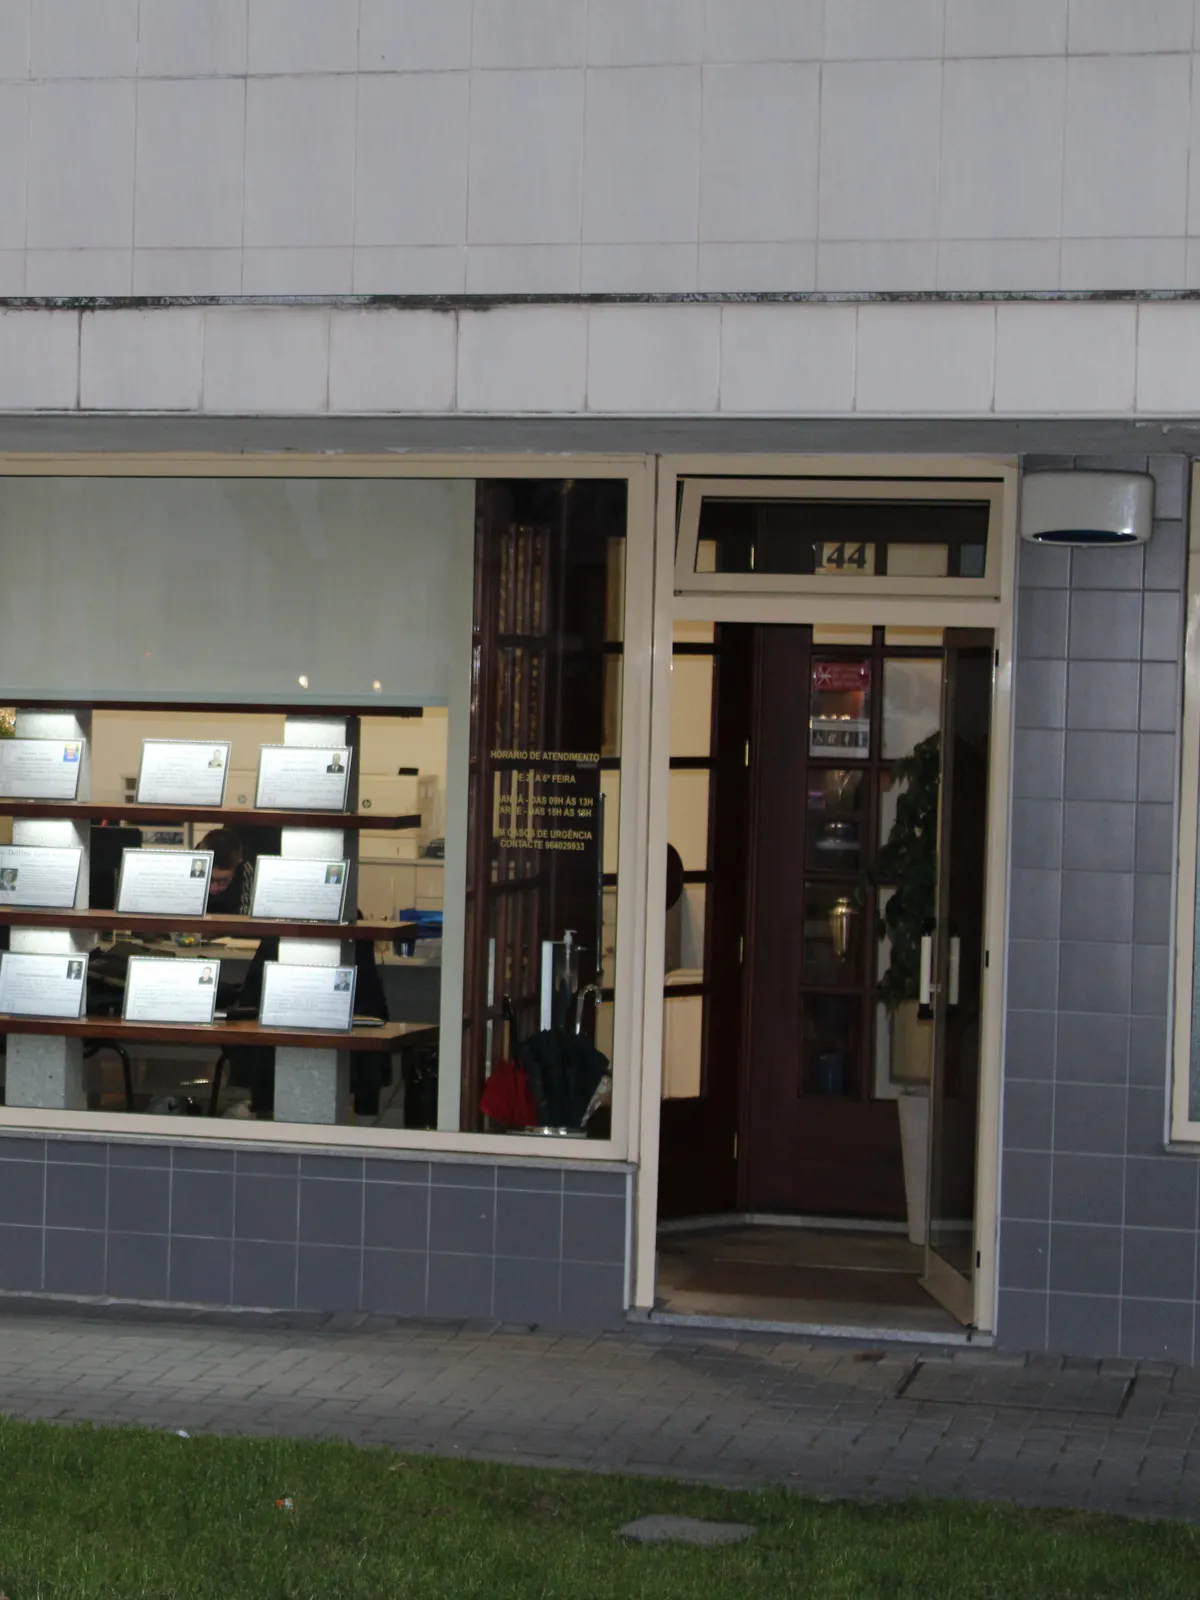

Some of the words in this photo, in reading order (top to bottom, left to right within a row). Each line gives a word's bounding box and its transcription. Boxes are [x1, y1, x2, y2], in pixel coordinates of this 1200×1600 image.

[813, 540, 867, 569] 144
[529, 751, 541, 761] DE
[542, 751, 600, 763] ATENDIMENTO
[552, 774, 576, 784] FEIRA
[548, 796, 564, 806] 09H
[579, 797, 594, 807] 13H
[547, 808, 562, 817] 15H
[537, 829, 548, 839] DE
[550, 828, 593, 840] URGÊNCIA
[500, 839, 544, 850] CONTACTE
